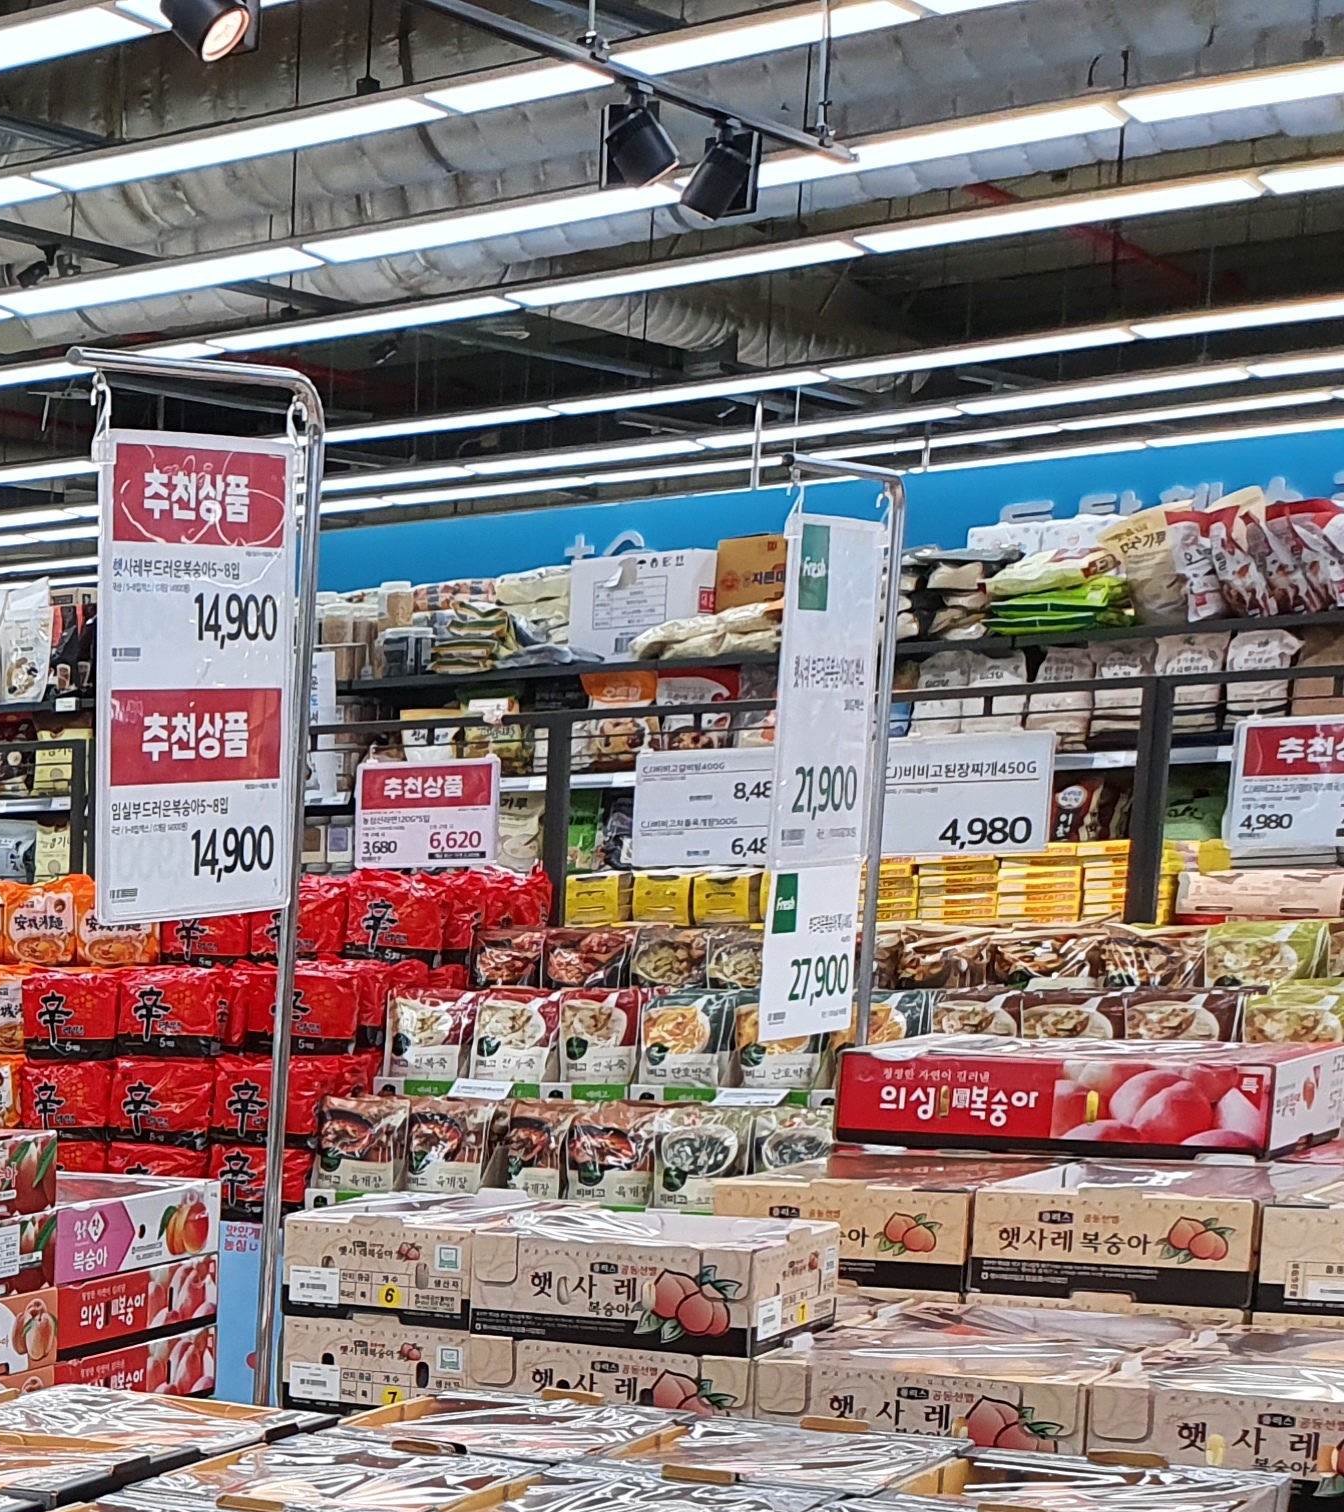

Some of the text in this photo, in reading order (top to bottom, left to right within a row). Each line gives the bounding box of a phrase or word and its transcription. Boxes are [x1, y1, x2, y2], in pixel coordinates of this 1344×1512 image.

[143, 468, 250, 524] 추천상품
[802, 556, 827, 578] Fresh
[193, 591, 278, 650] 14,900
[142, 710, 249, 762] 추천상품
[383, 774, 464, 800] 추천상품
[792, 765, 858, 821] 21,900
[429, 830, 482, 853] 6,620
[938, 815, 1033, 850] 4,980
[1239, 813, 1293, 832] 4,980
[191, 823, 275, 883] 14,900
[362, 840, 398, 857] 3,680
[362, 899, 400, 953] 辛
[787, 952, 850, 1007] 27,900
[133, 986, 171, 1043] 辛
[231, 1079, 269, 1137] 辛
[879, 1084, 1040, 1128] 의성 복숭아
[219, 1150, 257, 1206] 辛
[225, 1224, 261, 1239] 맛있게
[998, 1226, 1153, 1257] 햇사레 복숭아
[72, 1245, 108, 1273] 복숭아
[79, 1292, 145, 1330] 의성 복숭아
[384, 1288, 395, 1303] 6
[386, 1391, 398, 1404] 7
